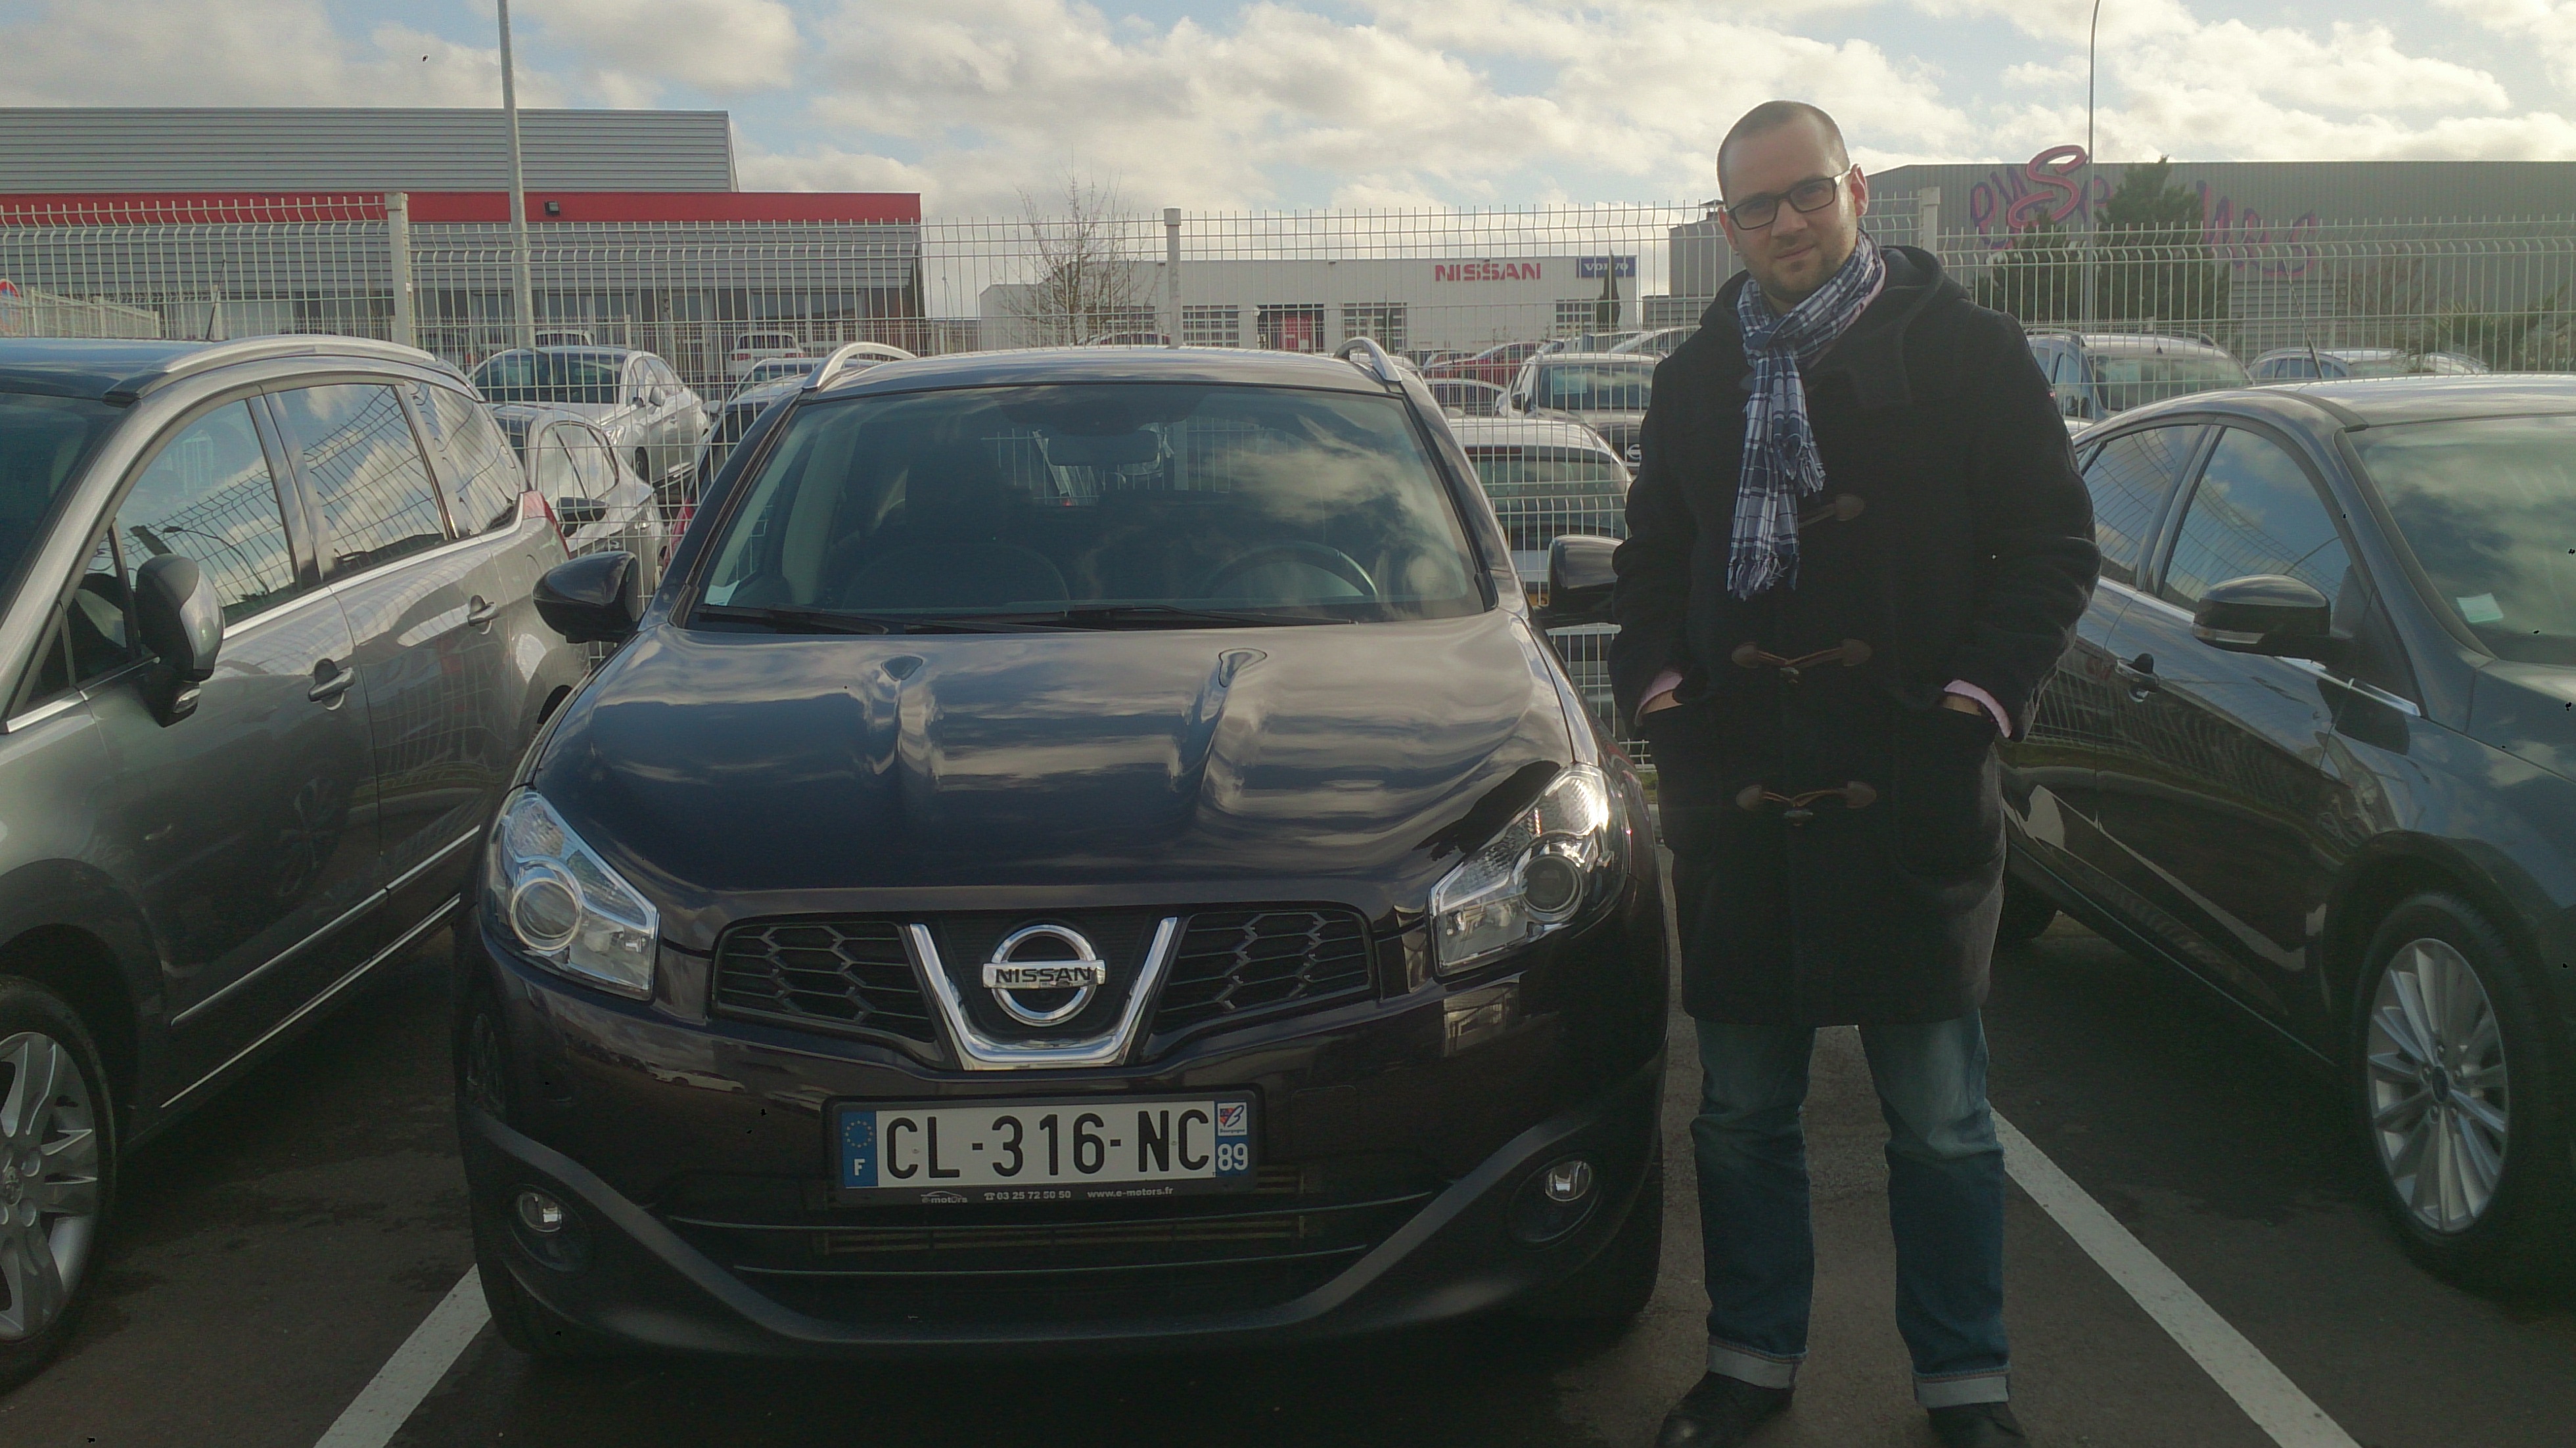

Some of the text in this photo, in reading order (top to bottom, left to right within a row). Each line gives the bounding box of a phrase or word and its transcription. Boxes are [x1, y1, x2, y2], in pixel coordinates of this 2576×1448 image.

[1435, 263, 1541, 281] NISSAN
[996, 966, 1091, 983] NISSAN
[886, 1108, 1210, 1179] CL-316-NC
[1218, 1143, 1248, 1171] 89
[854, 1158, 865, 1176] F
[996, 1190, 1071, 1200] 03 25 72 50 50
[1087, 1187, 1174, 1198] www.e-motors.fr
